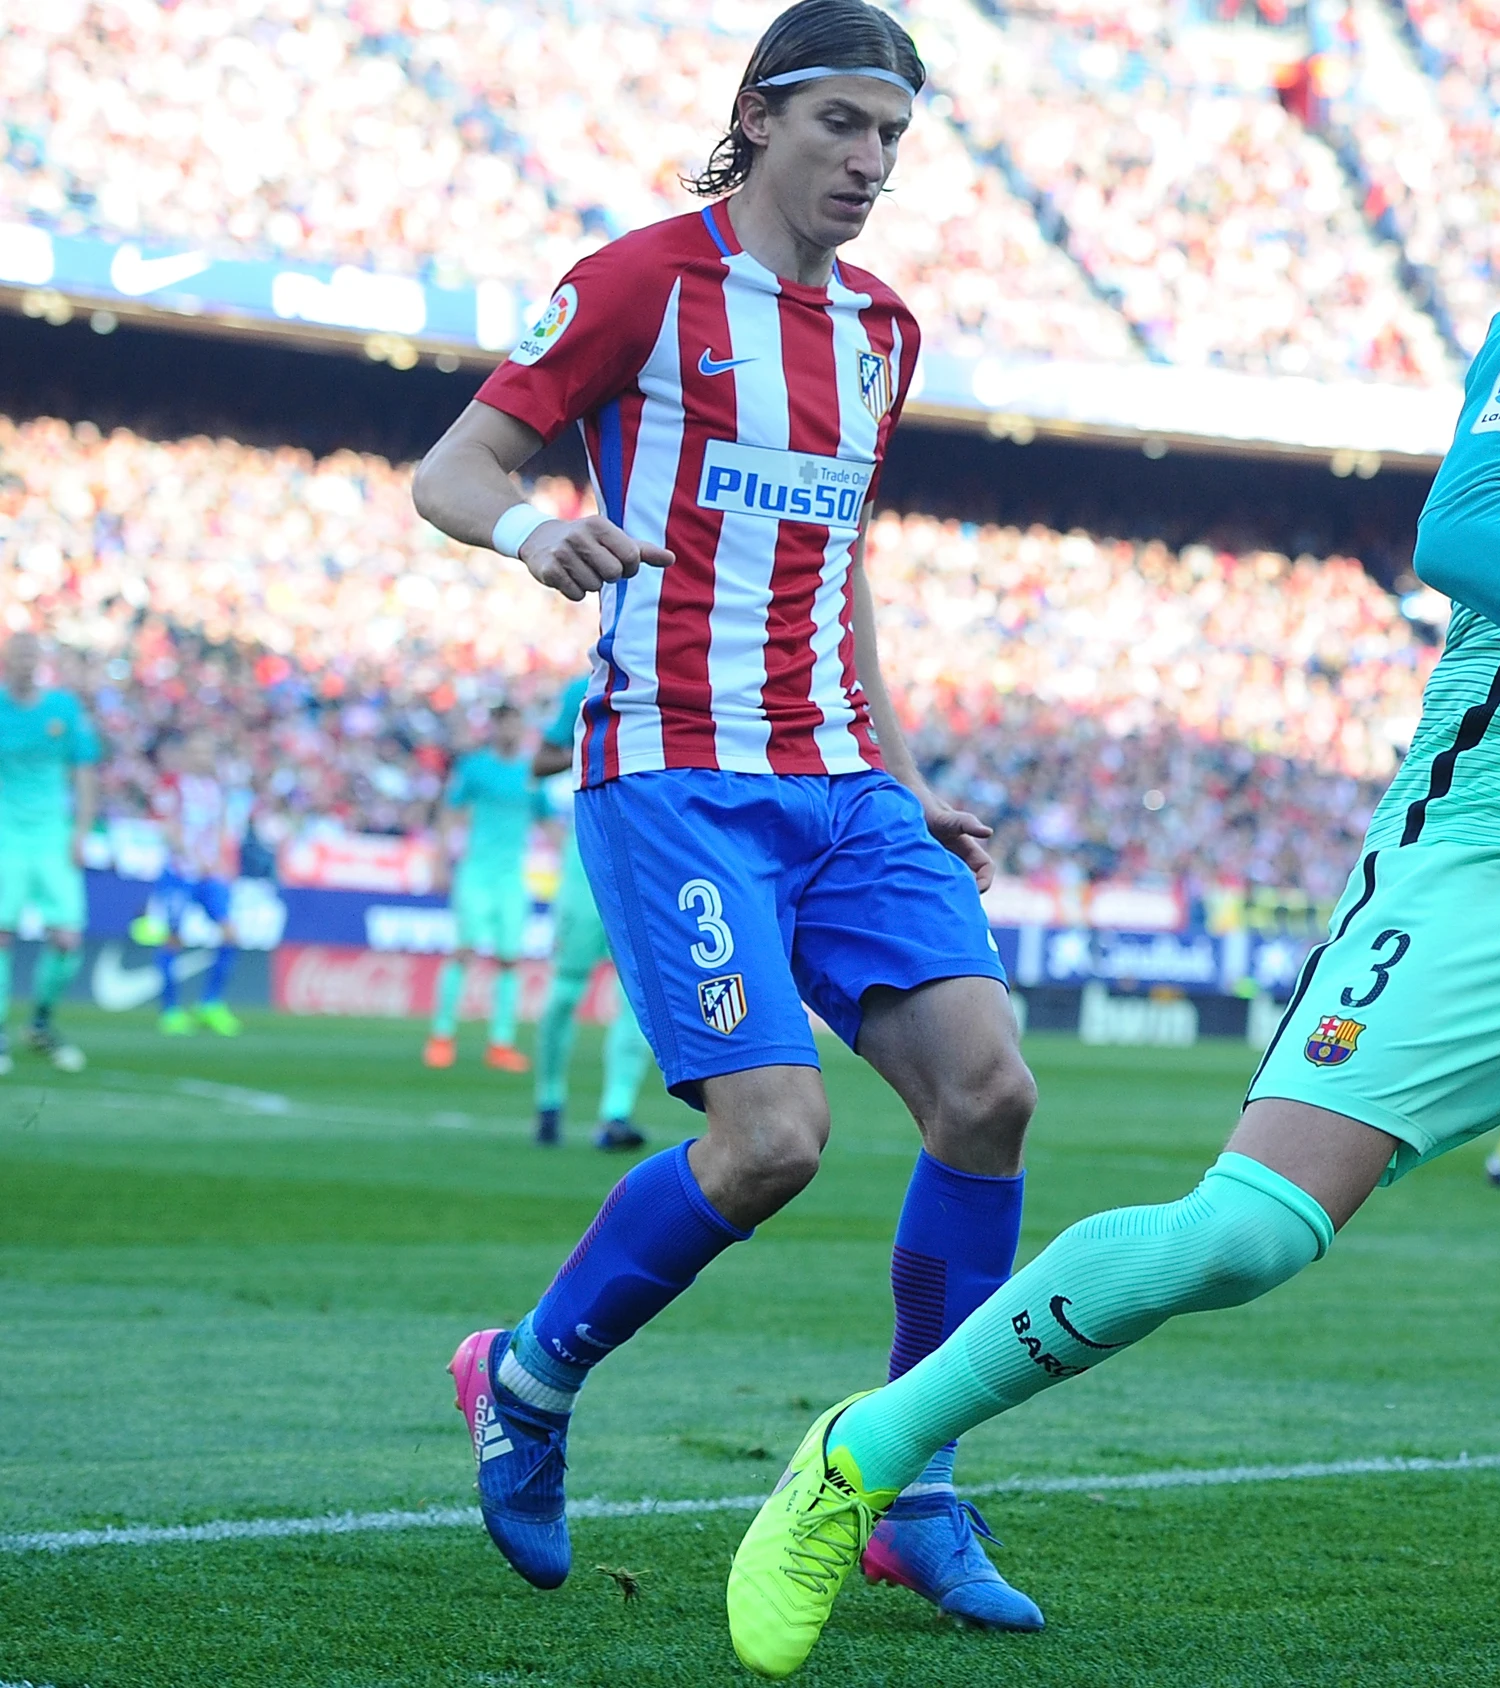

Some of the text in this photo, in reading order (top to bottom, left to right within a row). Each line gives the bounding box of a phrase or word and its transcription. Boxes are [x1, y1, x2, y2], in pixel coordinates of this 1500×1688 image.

[821, 467, 850, 484] Trade
[678, 878, 735, 969] 3
[1340, 929, 1411, 1008] 3
[824, 1466, 858, 1497] NIKE
